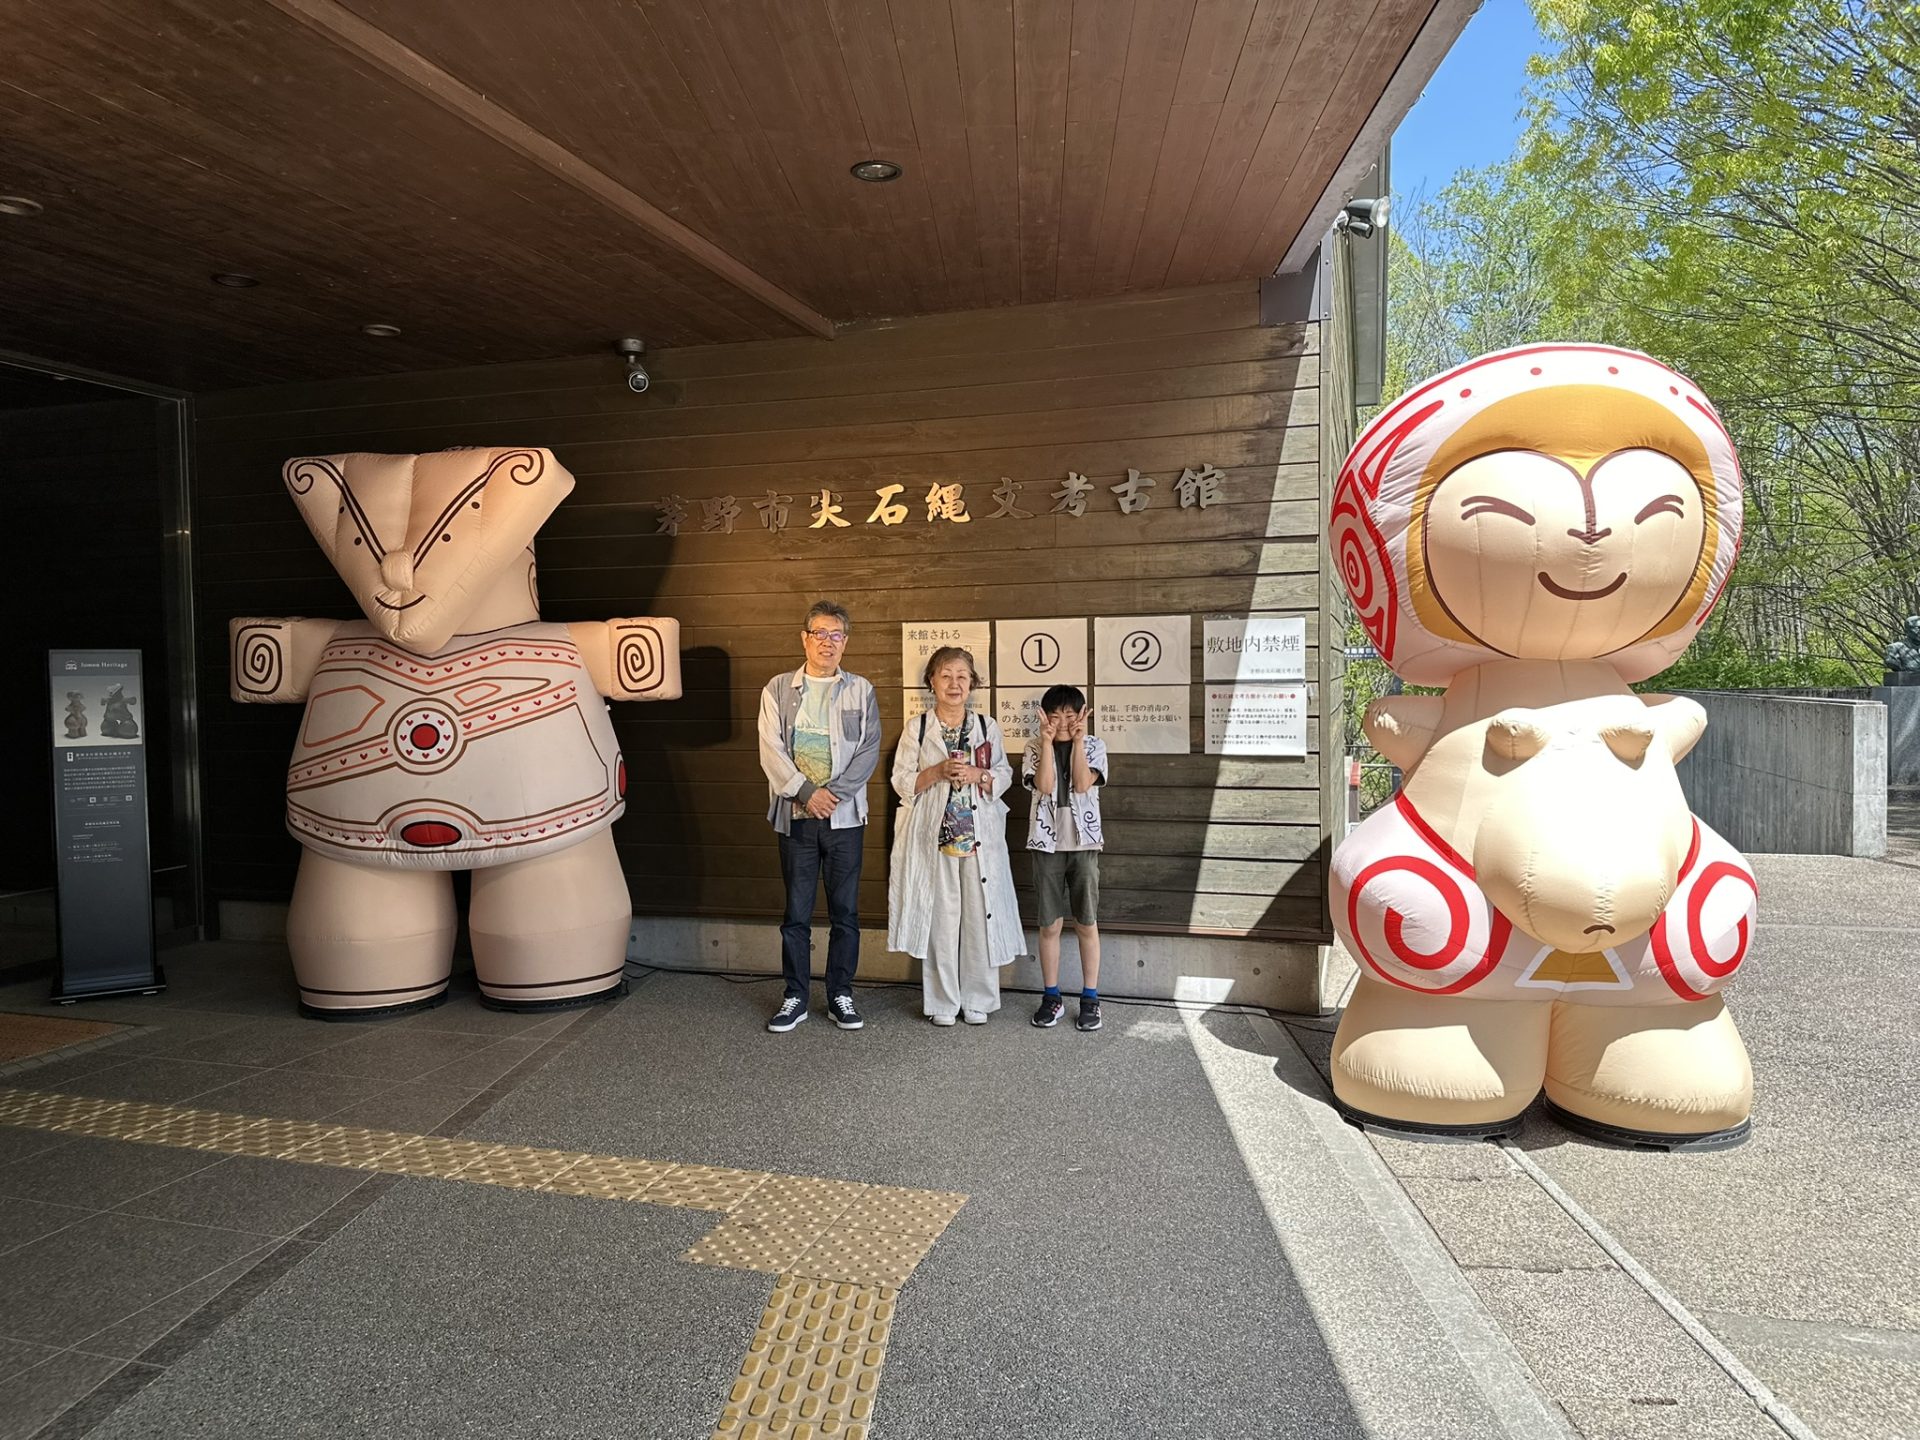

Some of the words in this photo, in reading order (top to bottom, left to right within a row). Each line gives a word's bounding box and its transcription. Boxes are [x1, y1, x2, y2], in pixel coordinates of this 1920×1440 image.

[653, 464, 1228, 537] 茅野市尖石縄文考古館
[907, 629, 961, 640] 来館される
[1206, 634, 1301, 654] 敷地内禁煙
[1101, 704, 1170, 713] 検温、手指の消毒の
[1101, 714, 1182, 723] 実施にご協力をお願い
[1101, 724, 1129, 733] します。
